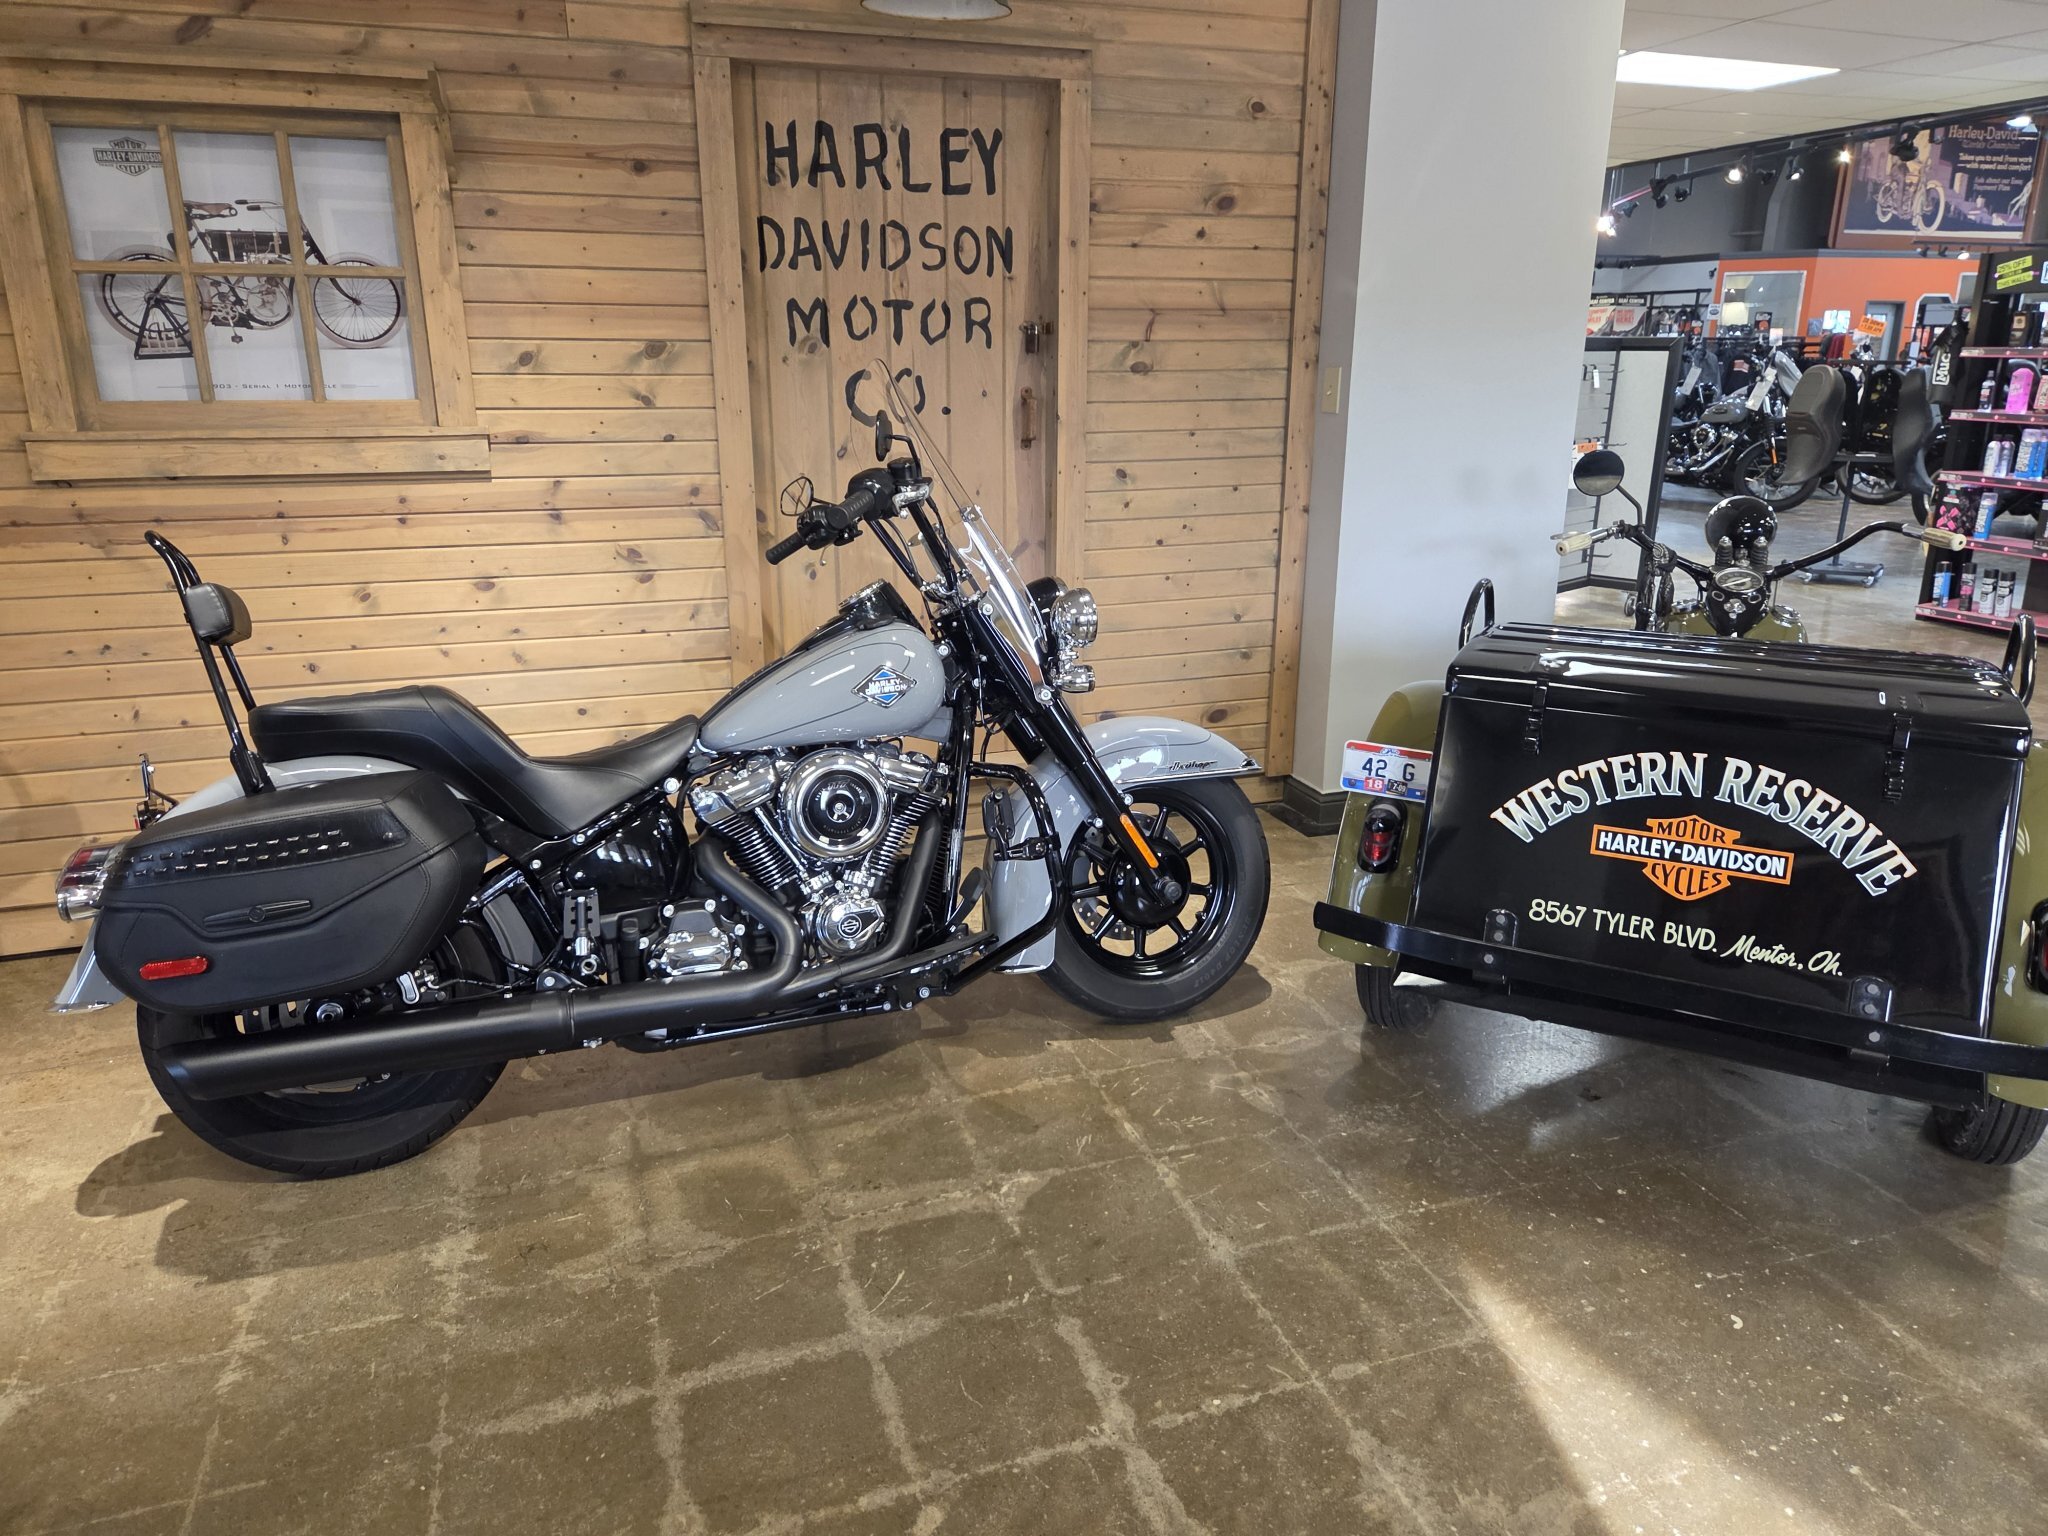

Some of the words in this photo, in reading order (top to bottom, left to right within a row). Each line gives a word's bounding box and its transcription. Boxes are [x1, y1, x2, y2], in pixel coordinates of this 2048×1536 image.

[113, 139, 143, 150] MOTOR
[1949, 125, 2024, 140] Harley-David
[118, 164, 147, 175] CYCLES
[765, 119, 1003, 195] HARLEY
[757, 216, 1013, 277] DAVIDSON
[787, 294, 991, 349] MOTOR
[845, 367, 951, 427] CO.
[1362, 757, 1387, 778] 42
[1402, 763, 1415, 782] G
[1366, 779, 1383, 790] 18
[1490, 751, 1708, 843] WESTERN
[1714, 756, 1918, 896] RESERVE
[1656, 818, 1726, 844] MOTOR
[1598, 831, 1786, 877] HARLEY-DAVIDSON
[1651, 862, 1723, 897] CYCLES
[1528, 898, 1587, 927] 8567
[1593, 908, 1655, 941] TYLER
[1663, 921, 1718, 953] BLVD.
[1719, 934, 1803, 970] Mentor,
[1807, 950, 1843, 976] Oh.
